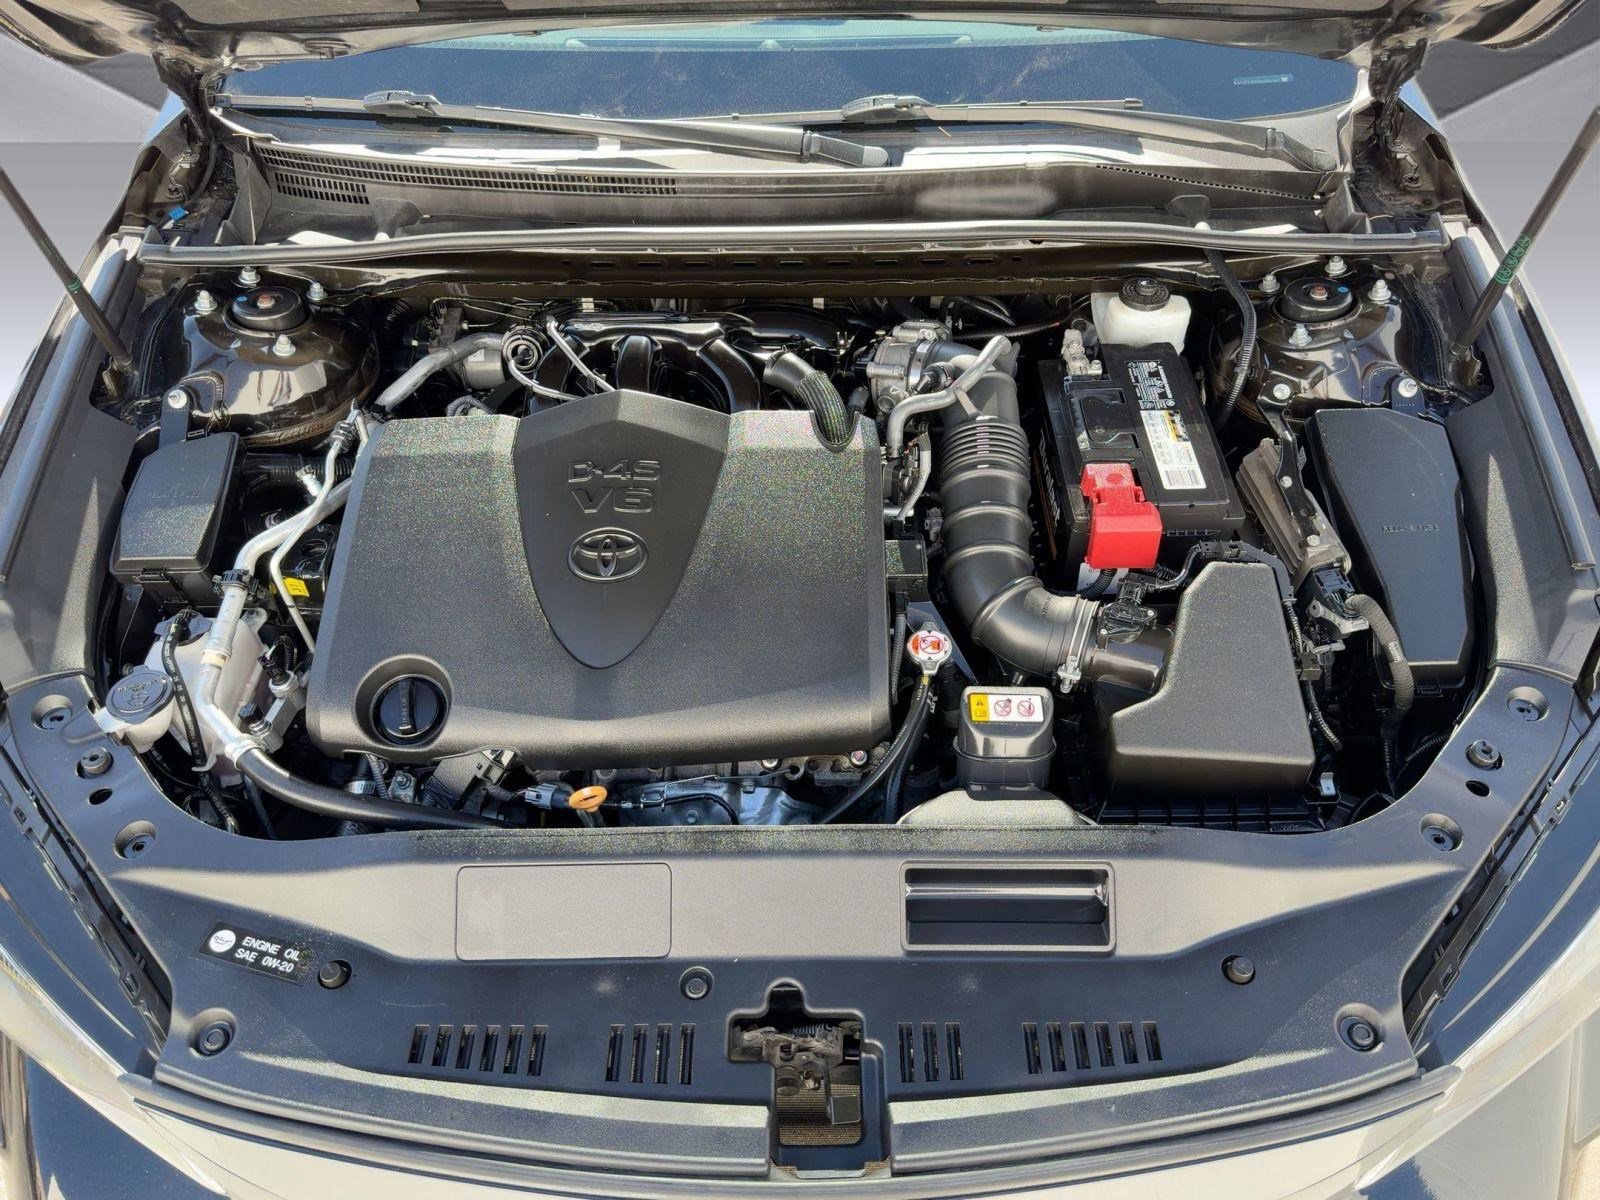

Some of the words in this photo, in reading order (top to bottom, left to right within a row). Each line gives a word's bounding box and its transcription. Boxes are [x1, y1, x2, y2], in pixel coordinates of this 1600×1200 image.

[568, 459, 660, 482] D-4S
[571, 487, 653, 513] V6
[235, 948, 258, 962] SAE
[262, 956, 295, 973] 0W-20
[242, 936, 281, 954] ENGINE
[284, 948, 300, 961] OIL
